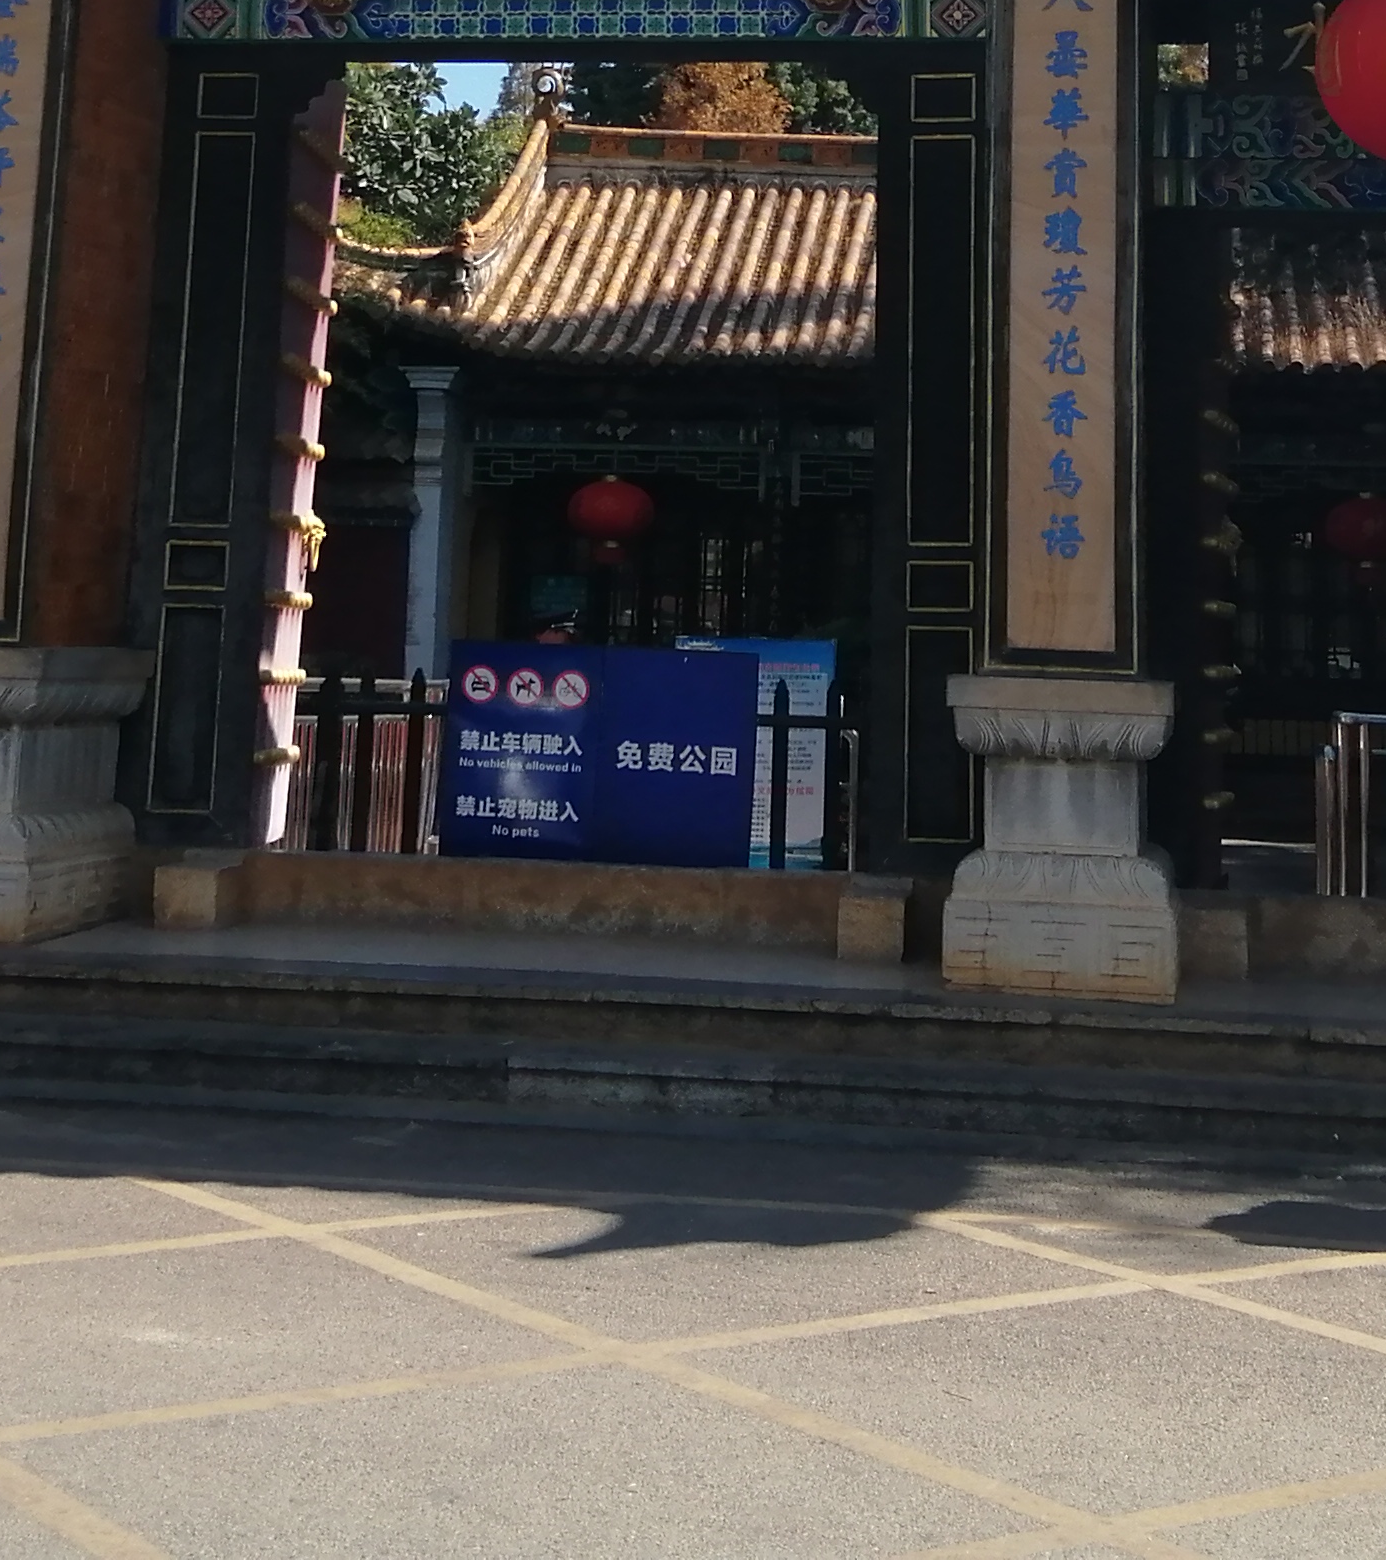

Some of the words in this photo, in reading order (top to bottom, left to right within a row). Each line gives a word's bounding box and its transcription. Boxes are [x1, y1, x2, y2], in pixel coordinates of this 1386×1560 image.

[459, 730, 583, 757] 禁止车辆驶入
[459, 757, 474, 767] No
[525, 760, 569, 773] allowed
[571, 762, 582, 773] in
[616, 740, 738, 776] 免费公园
[455, 794, 580, 822] 禁止宠物进入
[491, 824, 510, 837] No
[511, 825, 540, 839] pets
